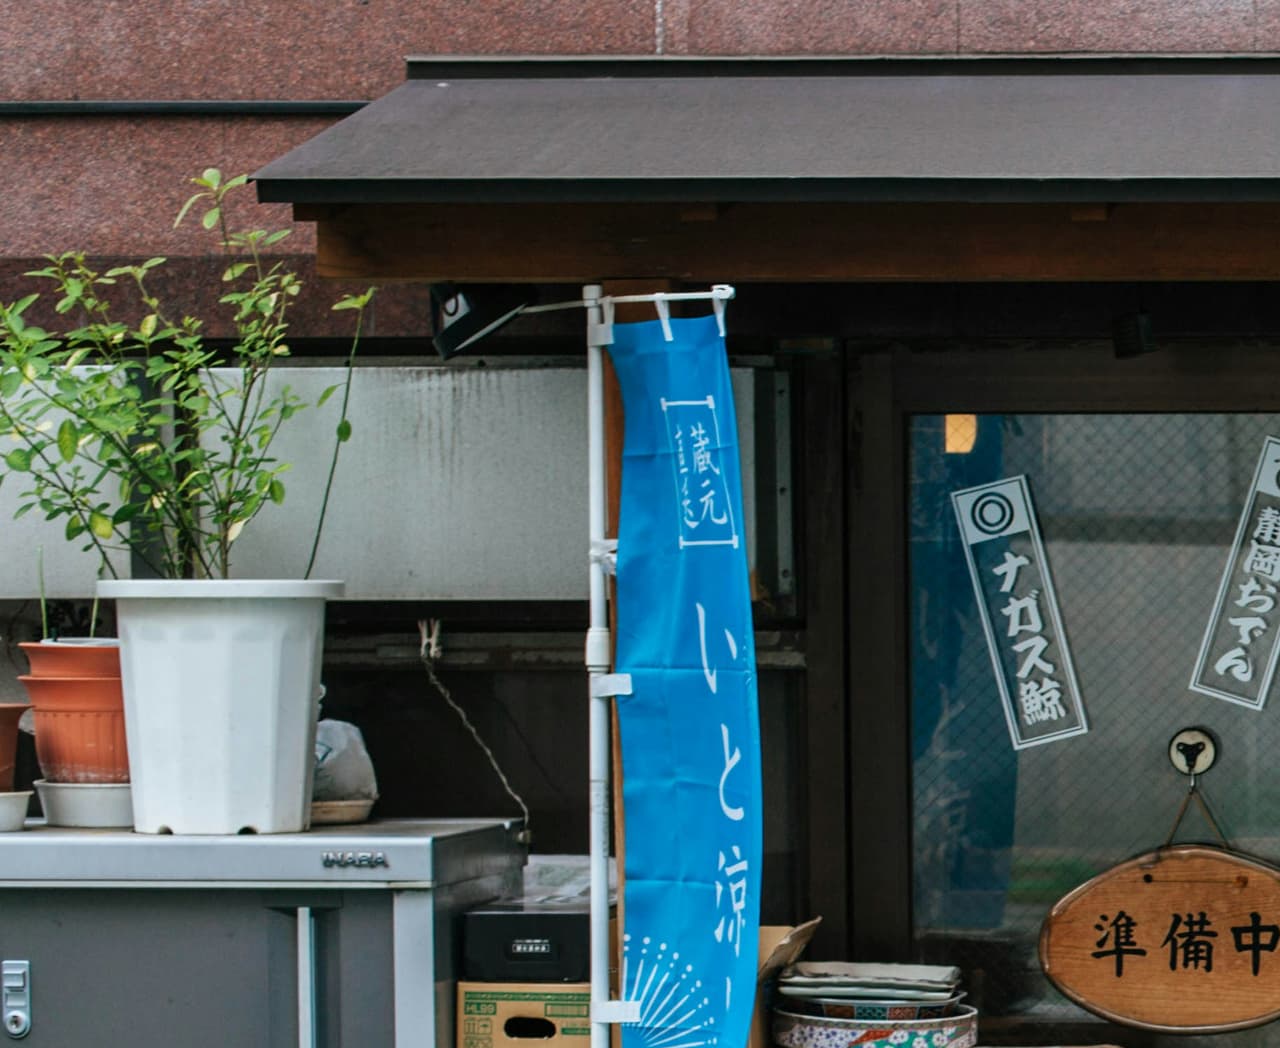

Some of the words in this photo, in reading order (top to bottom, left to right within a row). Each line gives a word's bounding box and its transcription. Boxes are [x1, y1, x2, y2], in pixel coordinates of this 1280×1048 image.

[690, 421, 728, 525] 蔵元
[993, 550, 1067, 726] ナガス鯨
